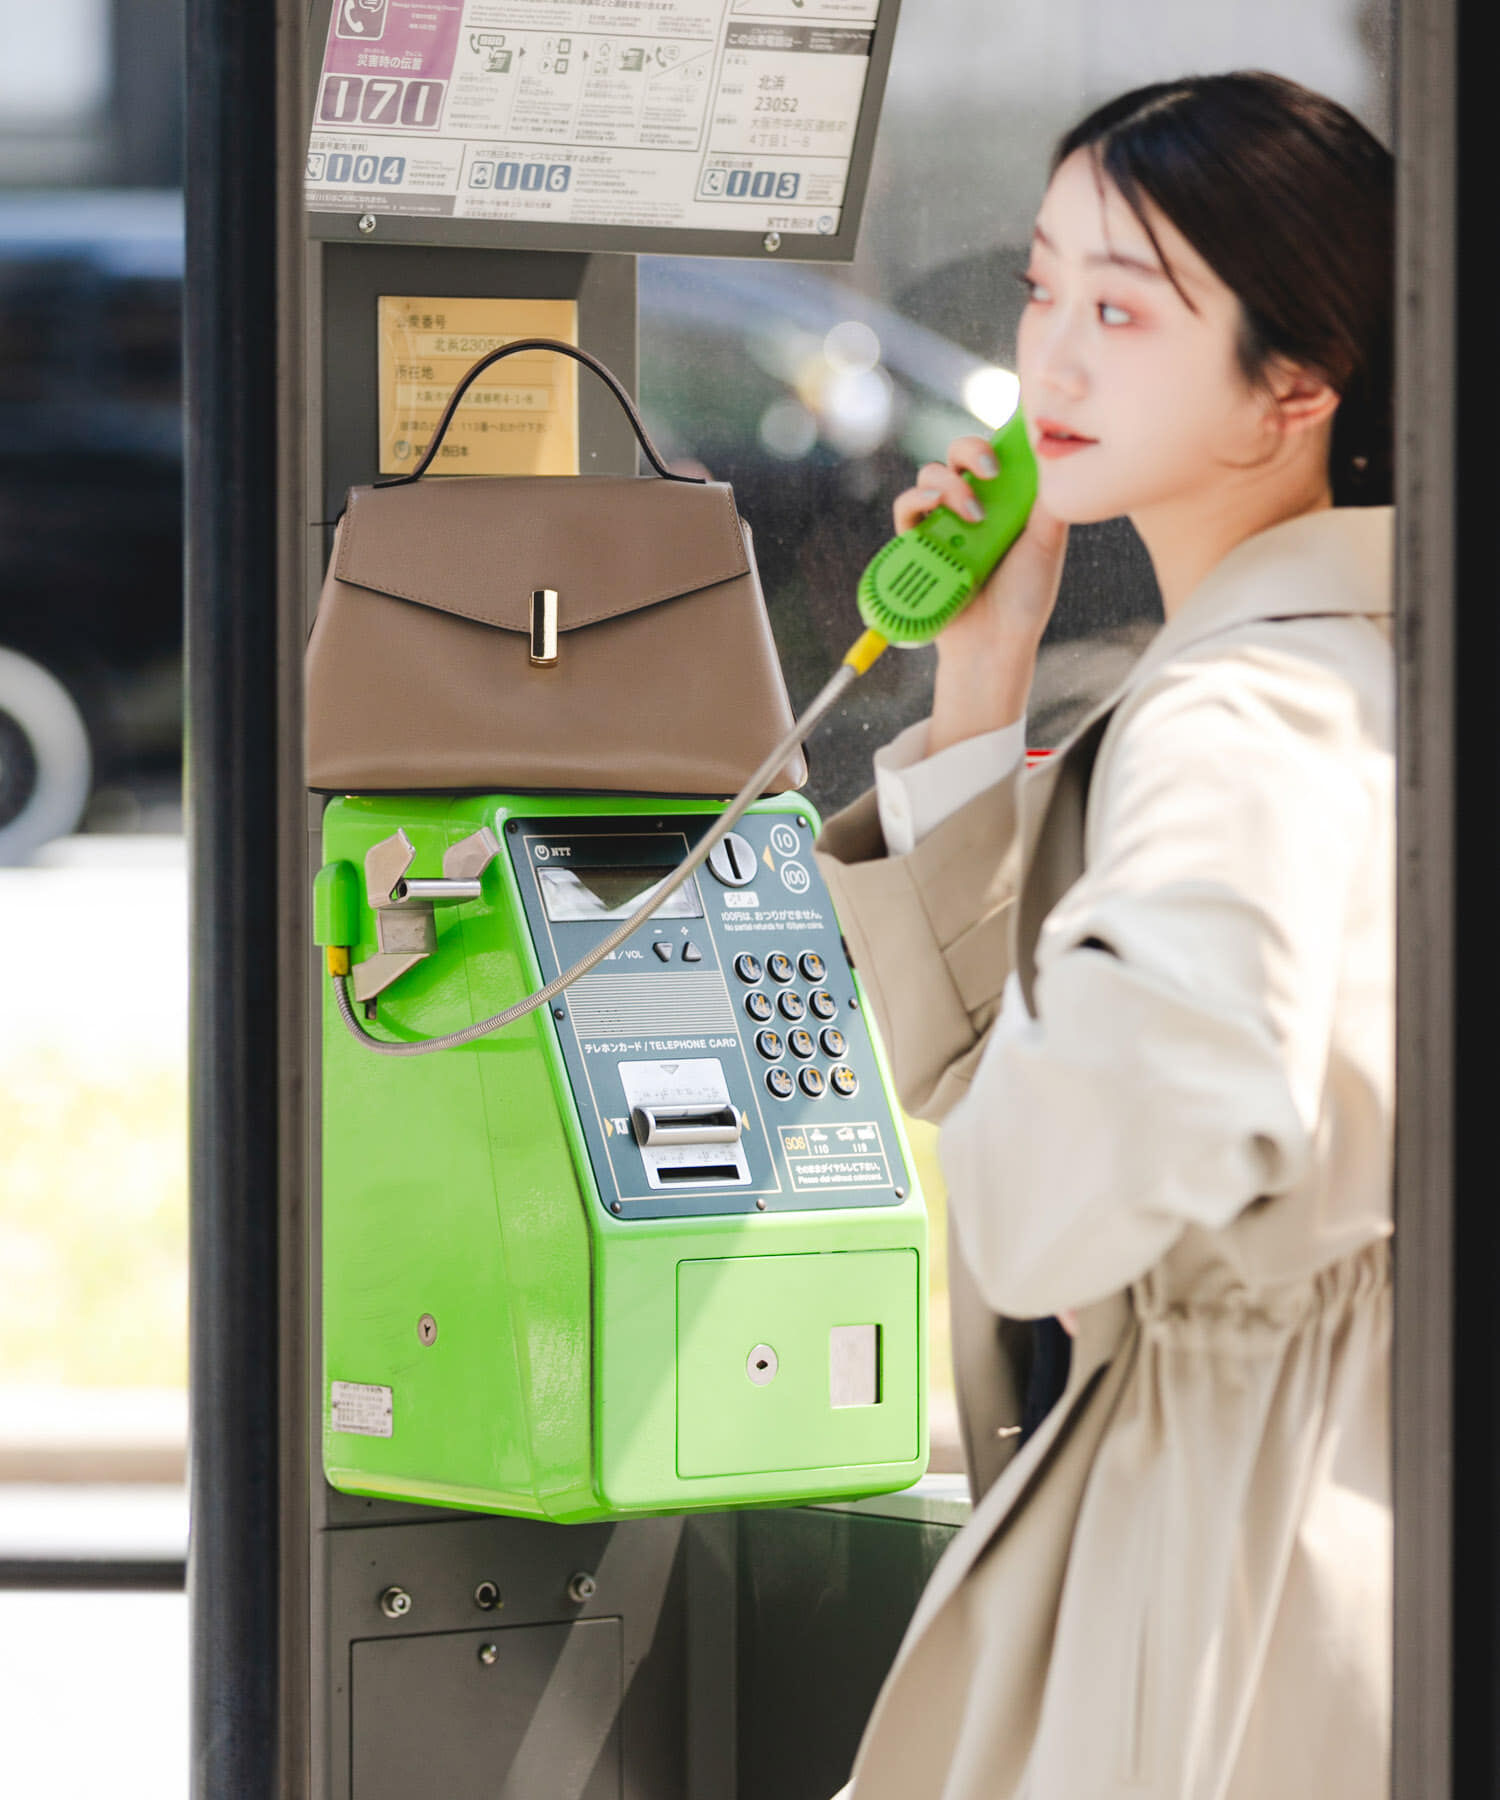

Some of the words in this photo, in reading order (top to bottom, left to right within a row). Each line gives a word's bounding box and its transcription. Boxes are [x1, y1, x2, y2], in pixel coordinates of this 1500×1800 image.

[333, 80, 429, 122] 171
[753, 96, 800, 113] 23052
[334, 156, 402, 182] 104
[501, 164, 566, 190] 116
[732, 169, 796, 198] 113
[776, 832, 793, 849] 10
[550, 847, 572, 857] NTT
[785, 869, 806, 885] 100
[625, 950, 644, 959] VOL
[584, 1040, 642, 1054] テレホンカード
[649, 1039, 707, 1050] TELEPHONE
[709, 1038, 737, 1048] CARD
[806, 1069, 823, 1092] 0
[785, 1137, 806, 1151] SOS
[814, 1144, 830, 1154] 110
